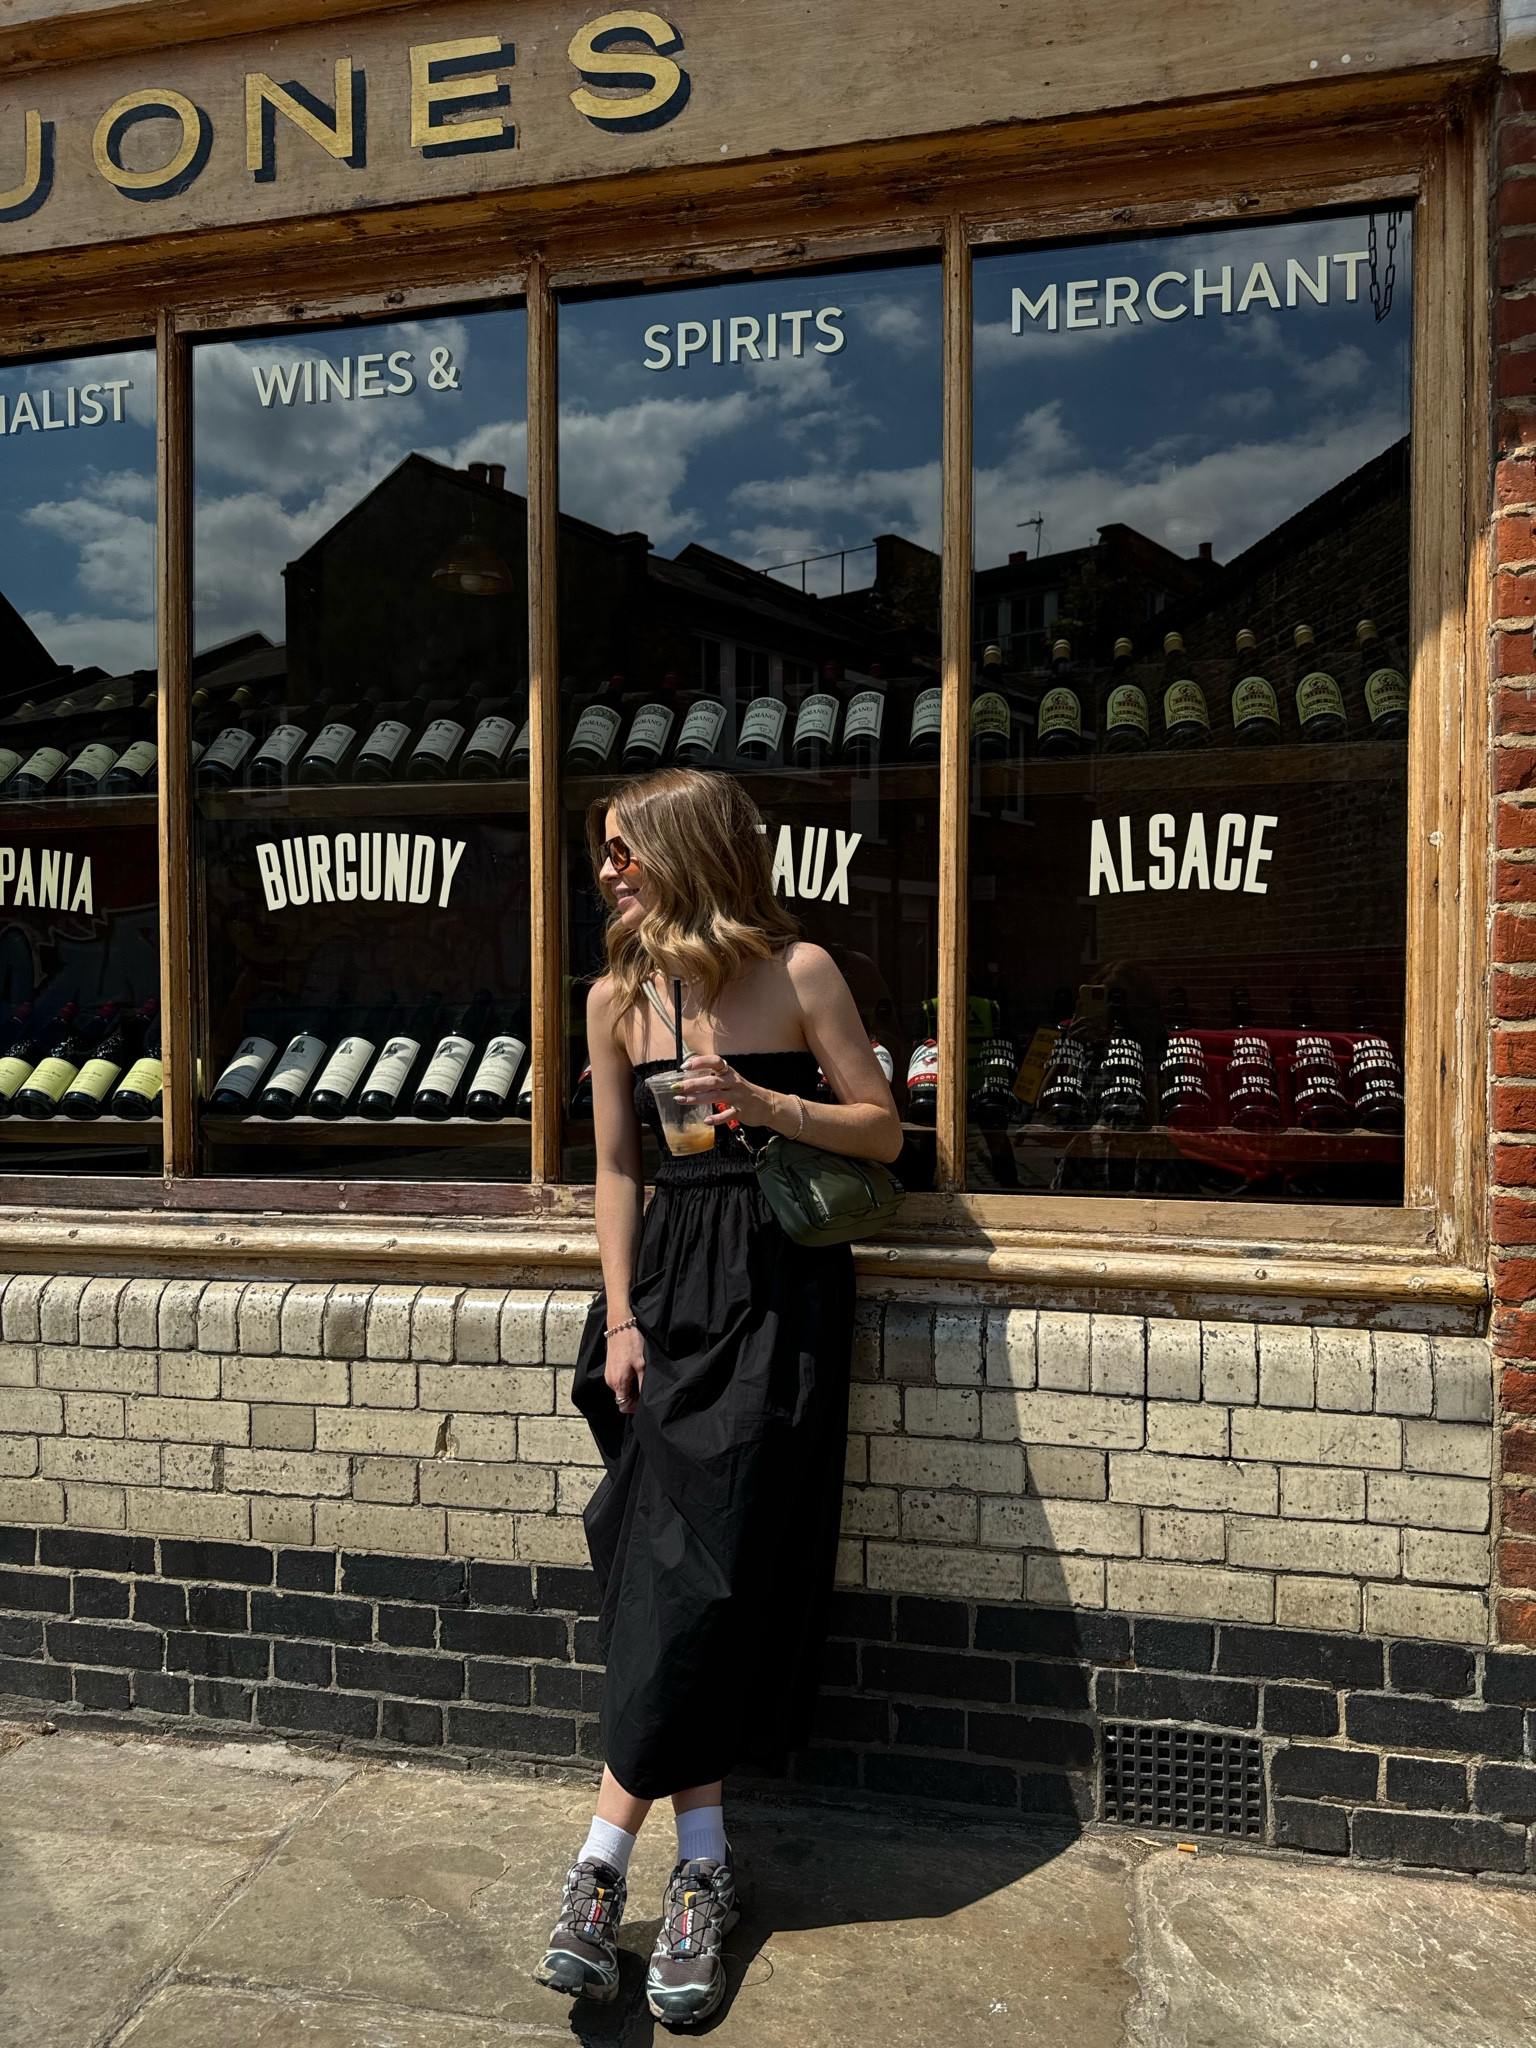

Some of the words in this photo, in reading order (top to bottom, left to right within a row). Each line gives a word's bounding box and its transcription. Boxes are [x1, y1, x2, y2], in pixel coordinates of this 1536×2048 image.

[0, 9, 688, 220] JONES
[1011, 250, 1371, 335] MERCHANT
[642, 306, 846, 370] SPIRITS
[251, 350, 414, 408] WINES
[427, 346, 459, 392] &
[0, 380, 129, 434] IALIST
[1089, 812, 1278, 896] ALSACE
[256, 832, 467, 911] BURGUNDY
[753, 824, 863, 905] AUX
[0, 847, 93, 915] PANIA
[1108, 1048, 1144, 1062] PORTO
[1166, 1047, 1204, 1058] PORTO
[1232, 1047, 1271, 1059] PORTO
[1295, 1047, 1335, 1058] PORTO
[1353, 1049, 1393, 1063] PORTO
[1348, 1059, 1401, 1078] COLHEITA
[984, 1076, 1010, 1087] 1982
[1057, 1076, 1082, 1087] 1982
[1115, 1076, 1141, 1088] 1982
[1174, 1075, 1202, 1086] 1982
[1242, 1076, 1270, 1086] 1982
[1307, 1076, 1336, 1086] 1982
[1365, 1079, 1395, 1090] 1982
[1043, 1086, 1062, 1098] AGED
[1100, 1087, 1121, 1099] AGED
[1161, 1086, 1180, 1101] AGED
[1229, 1087, 1249, 1102] AGED
[1295, 1088, 1315, 1104] AGED
[1355, 1093, 1373, 1109] AGED
[583, 1898, 598, 1933] SAOMON
